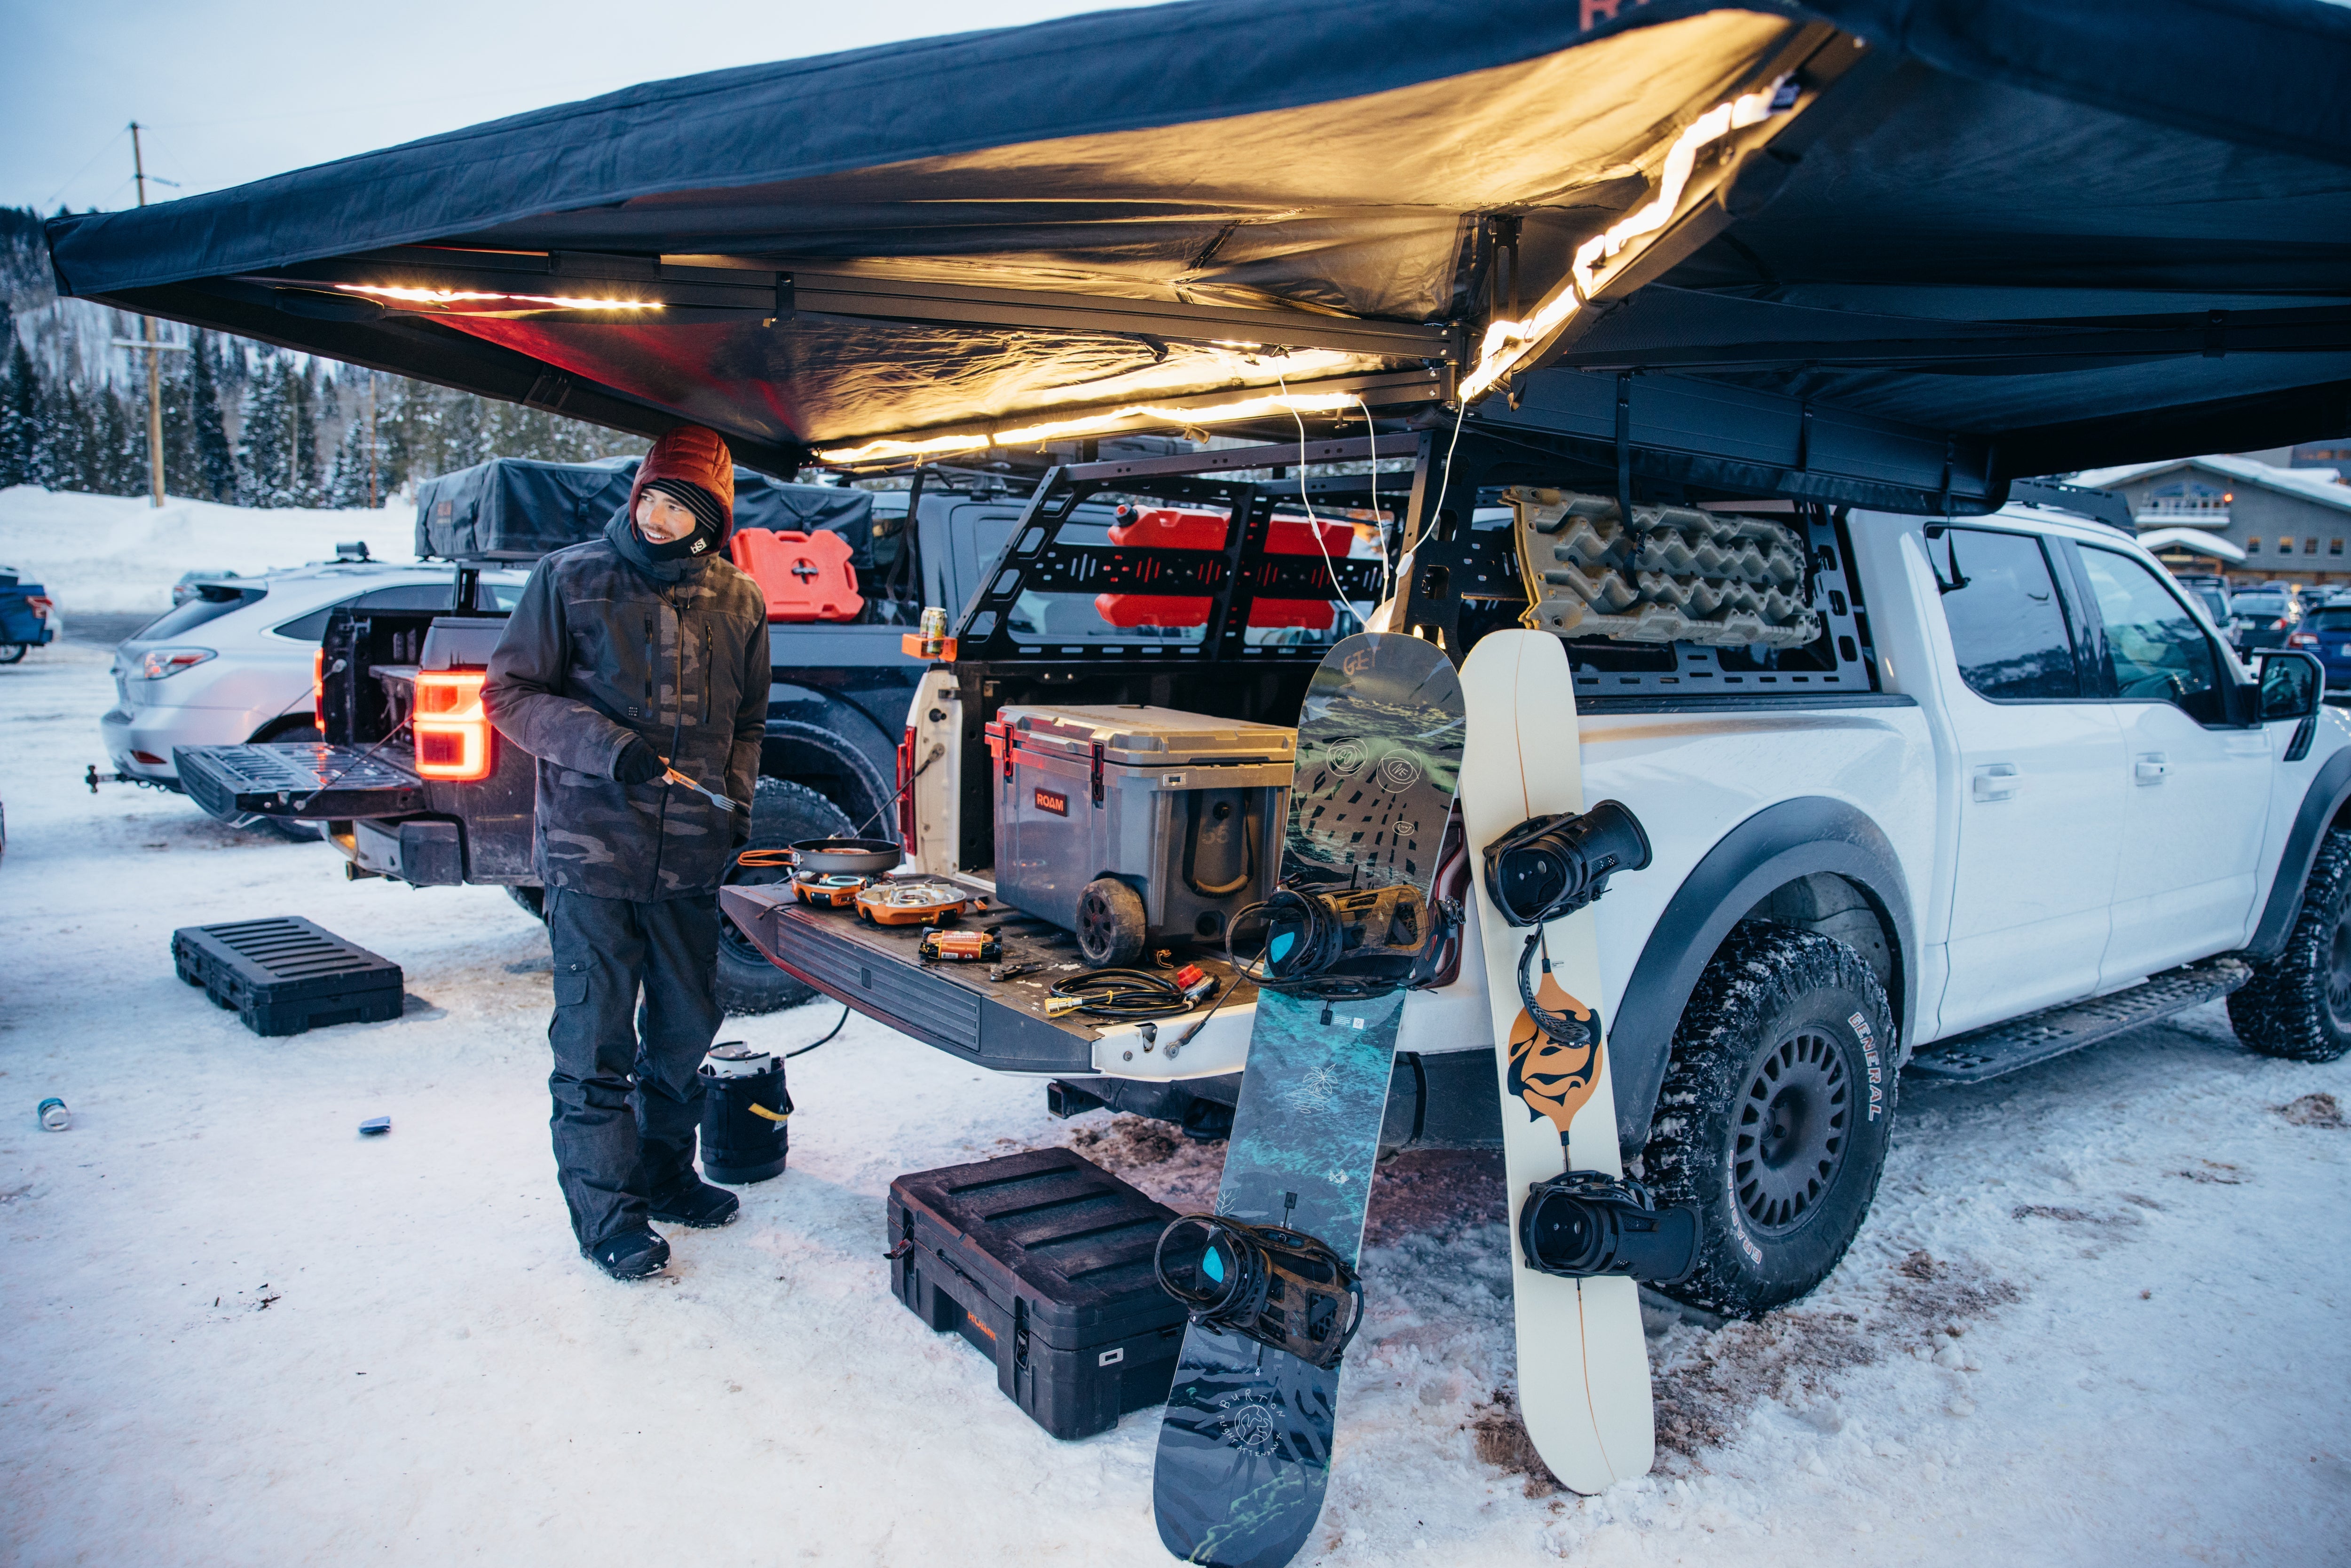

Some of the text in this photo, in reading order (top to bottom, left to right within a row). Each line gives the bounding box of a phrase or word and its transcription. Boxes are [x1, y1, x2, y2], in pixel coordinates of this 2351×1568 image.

[1343, 646, 1381, 676] GET
[1338, 749, 1409, 776] GO NE
[1037, 793, 1064, 812] ROAM
[1848, 1011, 1882, 1122] GENERAL
[967, 1310, 995, 1341] ROAM
[1219, 1388, 1286, 1417] BURTON
